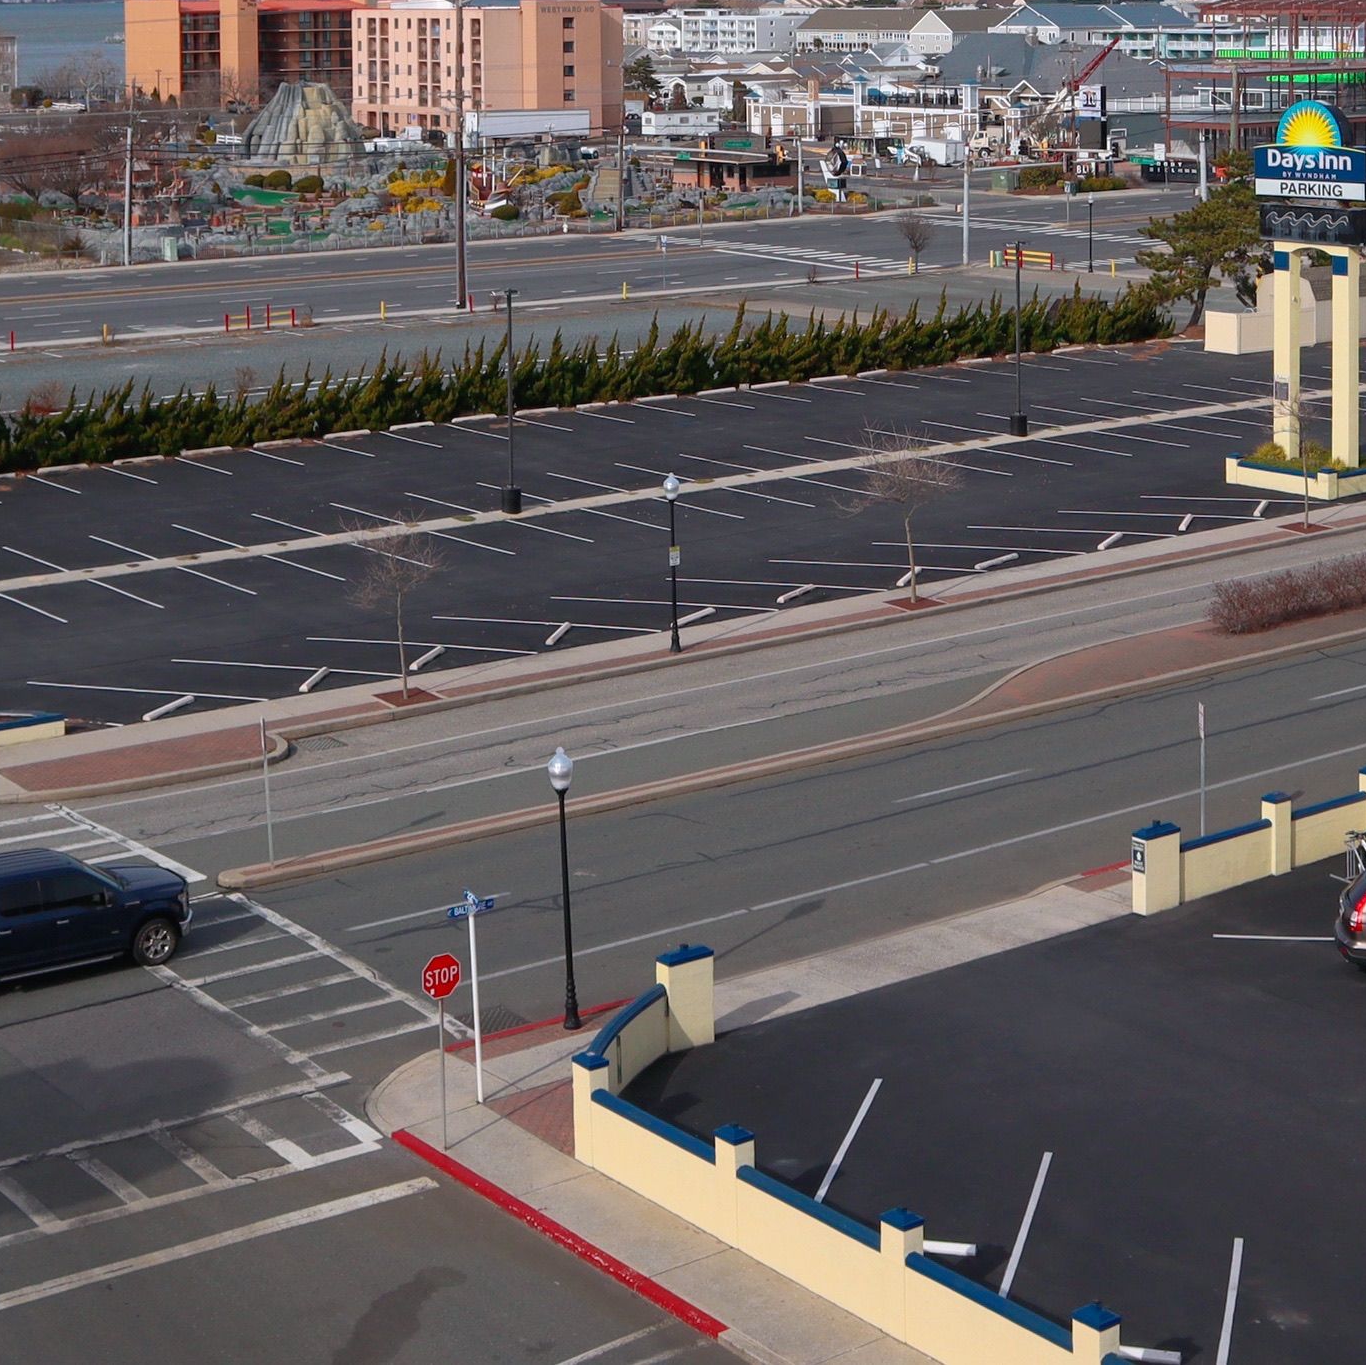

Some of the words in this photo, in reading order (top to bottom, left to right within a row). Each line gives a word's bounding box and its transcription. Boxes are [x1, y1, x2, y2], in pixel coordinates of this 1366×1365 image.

[1267, 148, 1316, 171] Days
[1318, 151, 1352, 171] Inn
[1295, 172, 1337, 180] WYNDHAM
[1280, 182, 1343, 197] PARKING
[425, 965, 458, 987] STOP
